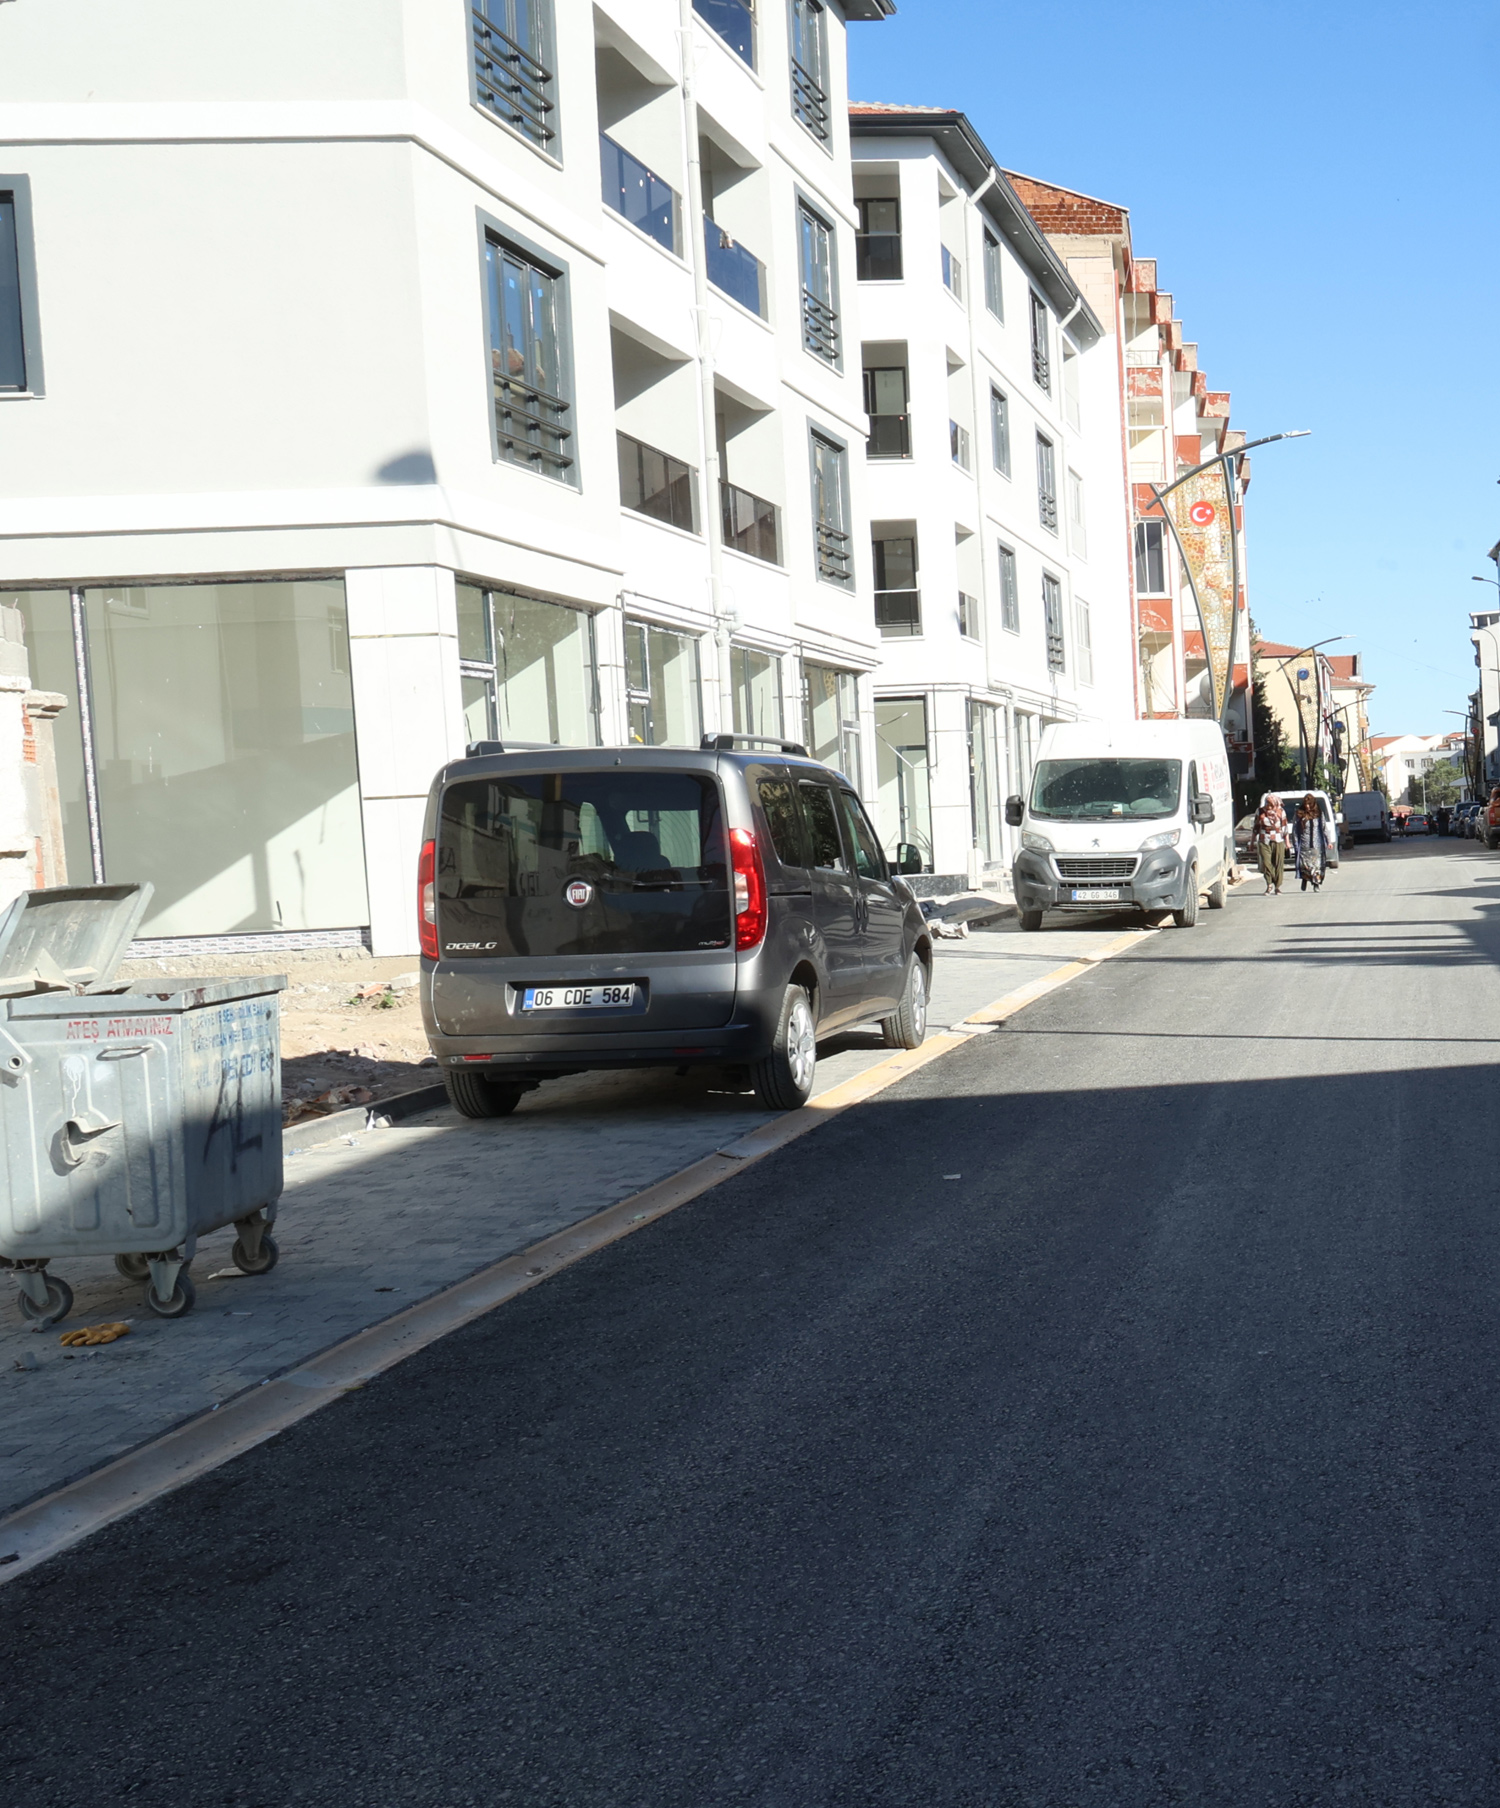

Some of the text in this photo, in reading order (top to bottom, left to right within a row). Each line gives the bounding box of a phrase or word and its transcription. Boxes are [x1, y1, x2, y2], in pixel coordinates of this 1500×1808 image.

[572, 888, 586, 900] FIAT
[1077, 891, 1087, 899] 42
[445, 941, 498, 950] DOBLO
[534, 990, 554, 1006] 06
[564, 988, 593, 1005] CDE
[602, 987, 631, 1004] 584
[66, 1016, 174, 1043] ATEŞ ATMAYINIZ
